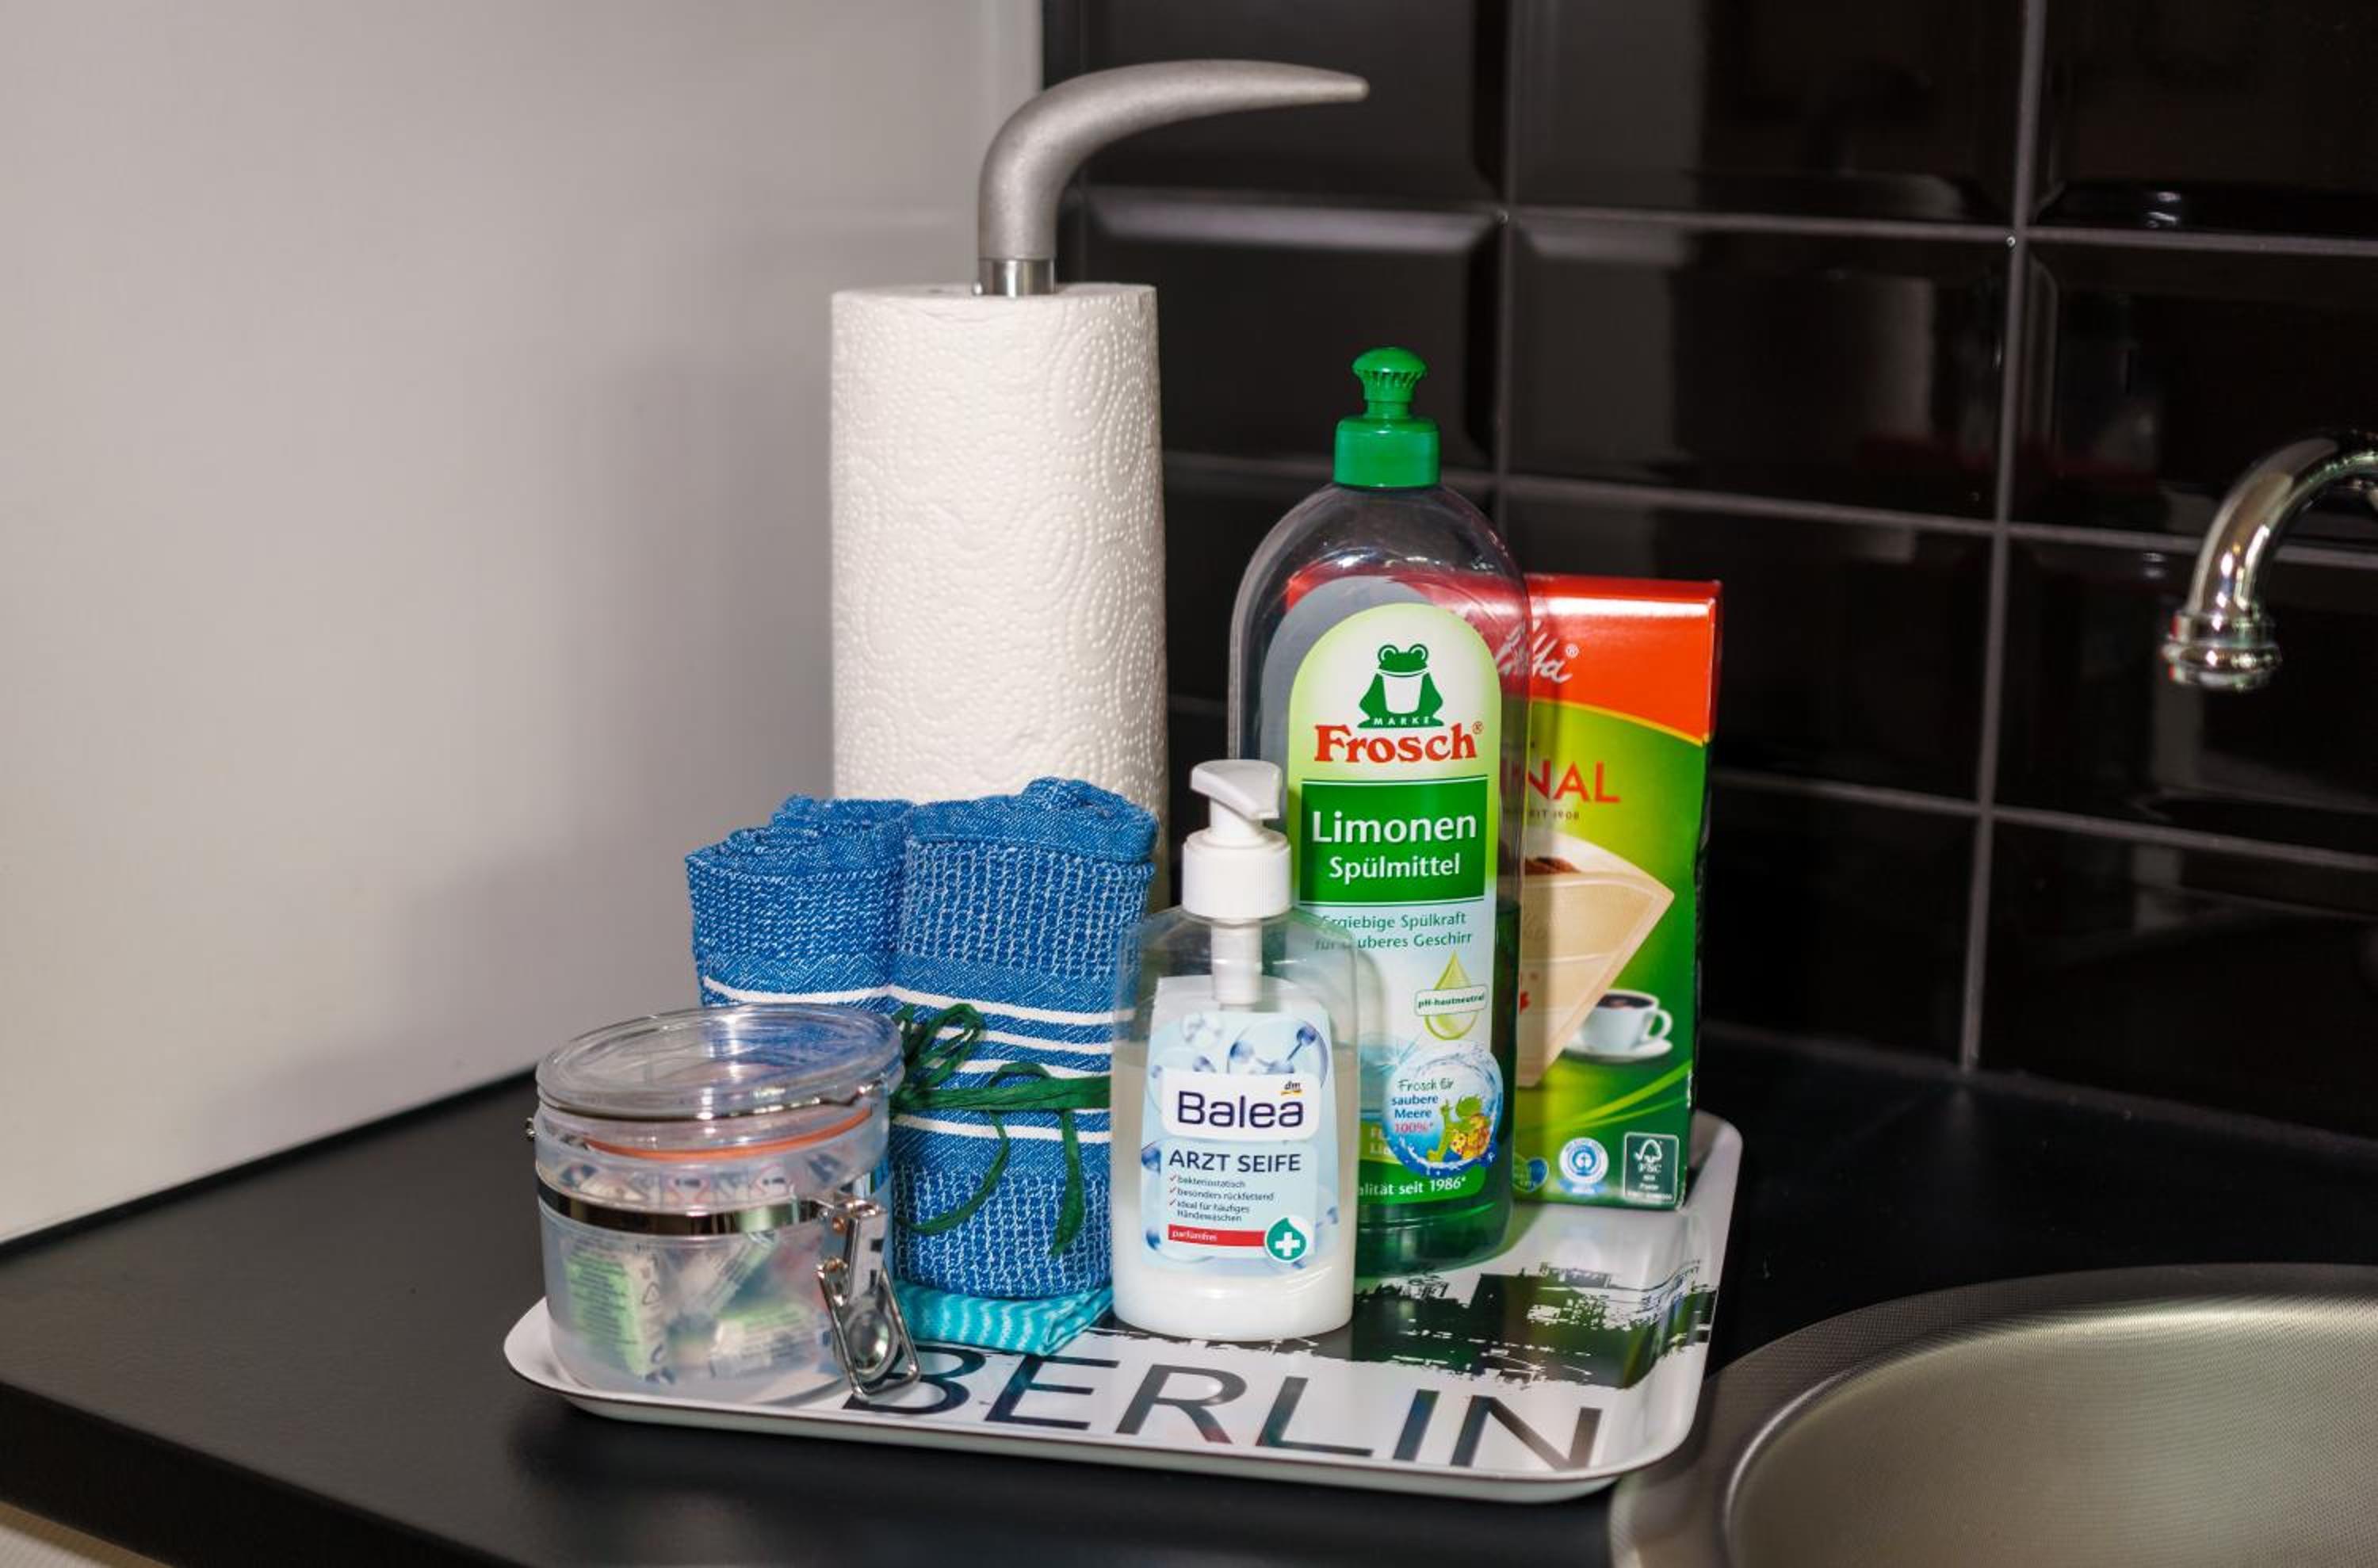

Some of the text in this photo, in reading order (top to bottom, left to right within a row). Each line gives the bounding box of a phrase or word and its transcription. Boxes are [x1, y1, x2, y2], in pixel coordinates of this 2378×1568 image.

[1372, 716, 1430, 726] MARKE
[1314, 723, 1478, 763] Frosch
[1313, 810, 1478, 843] Limonen
[1329, 852, 1461, 885] Spülmittel
[1401, 911, 1466, 931] Spülkraft
[1413, 931, 1473, 948] Geschirr
[1283, 1080, 1301, 1092] dm
[1397, 1078, 1437, 1092] Frosch
[1391, 1094, 1439, 1107] saubere
[1177, 1090, 1304, 1129] Balea
[1394, 1108, 1432, 1119] Meere
[1168, 1149, 1302, 1172] ARZT SEIFE
[1177, 1187, 1221, 1200] besonders
[1398, 1180, 1424, 1195] seit
[1177, 1200, 1250, 1214] ideal für häufiges
[1177, 1209, 1242, 1222] Händewaschen
[843, 1344, 1603, 1471] BERLIN
